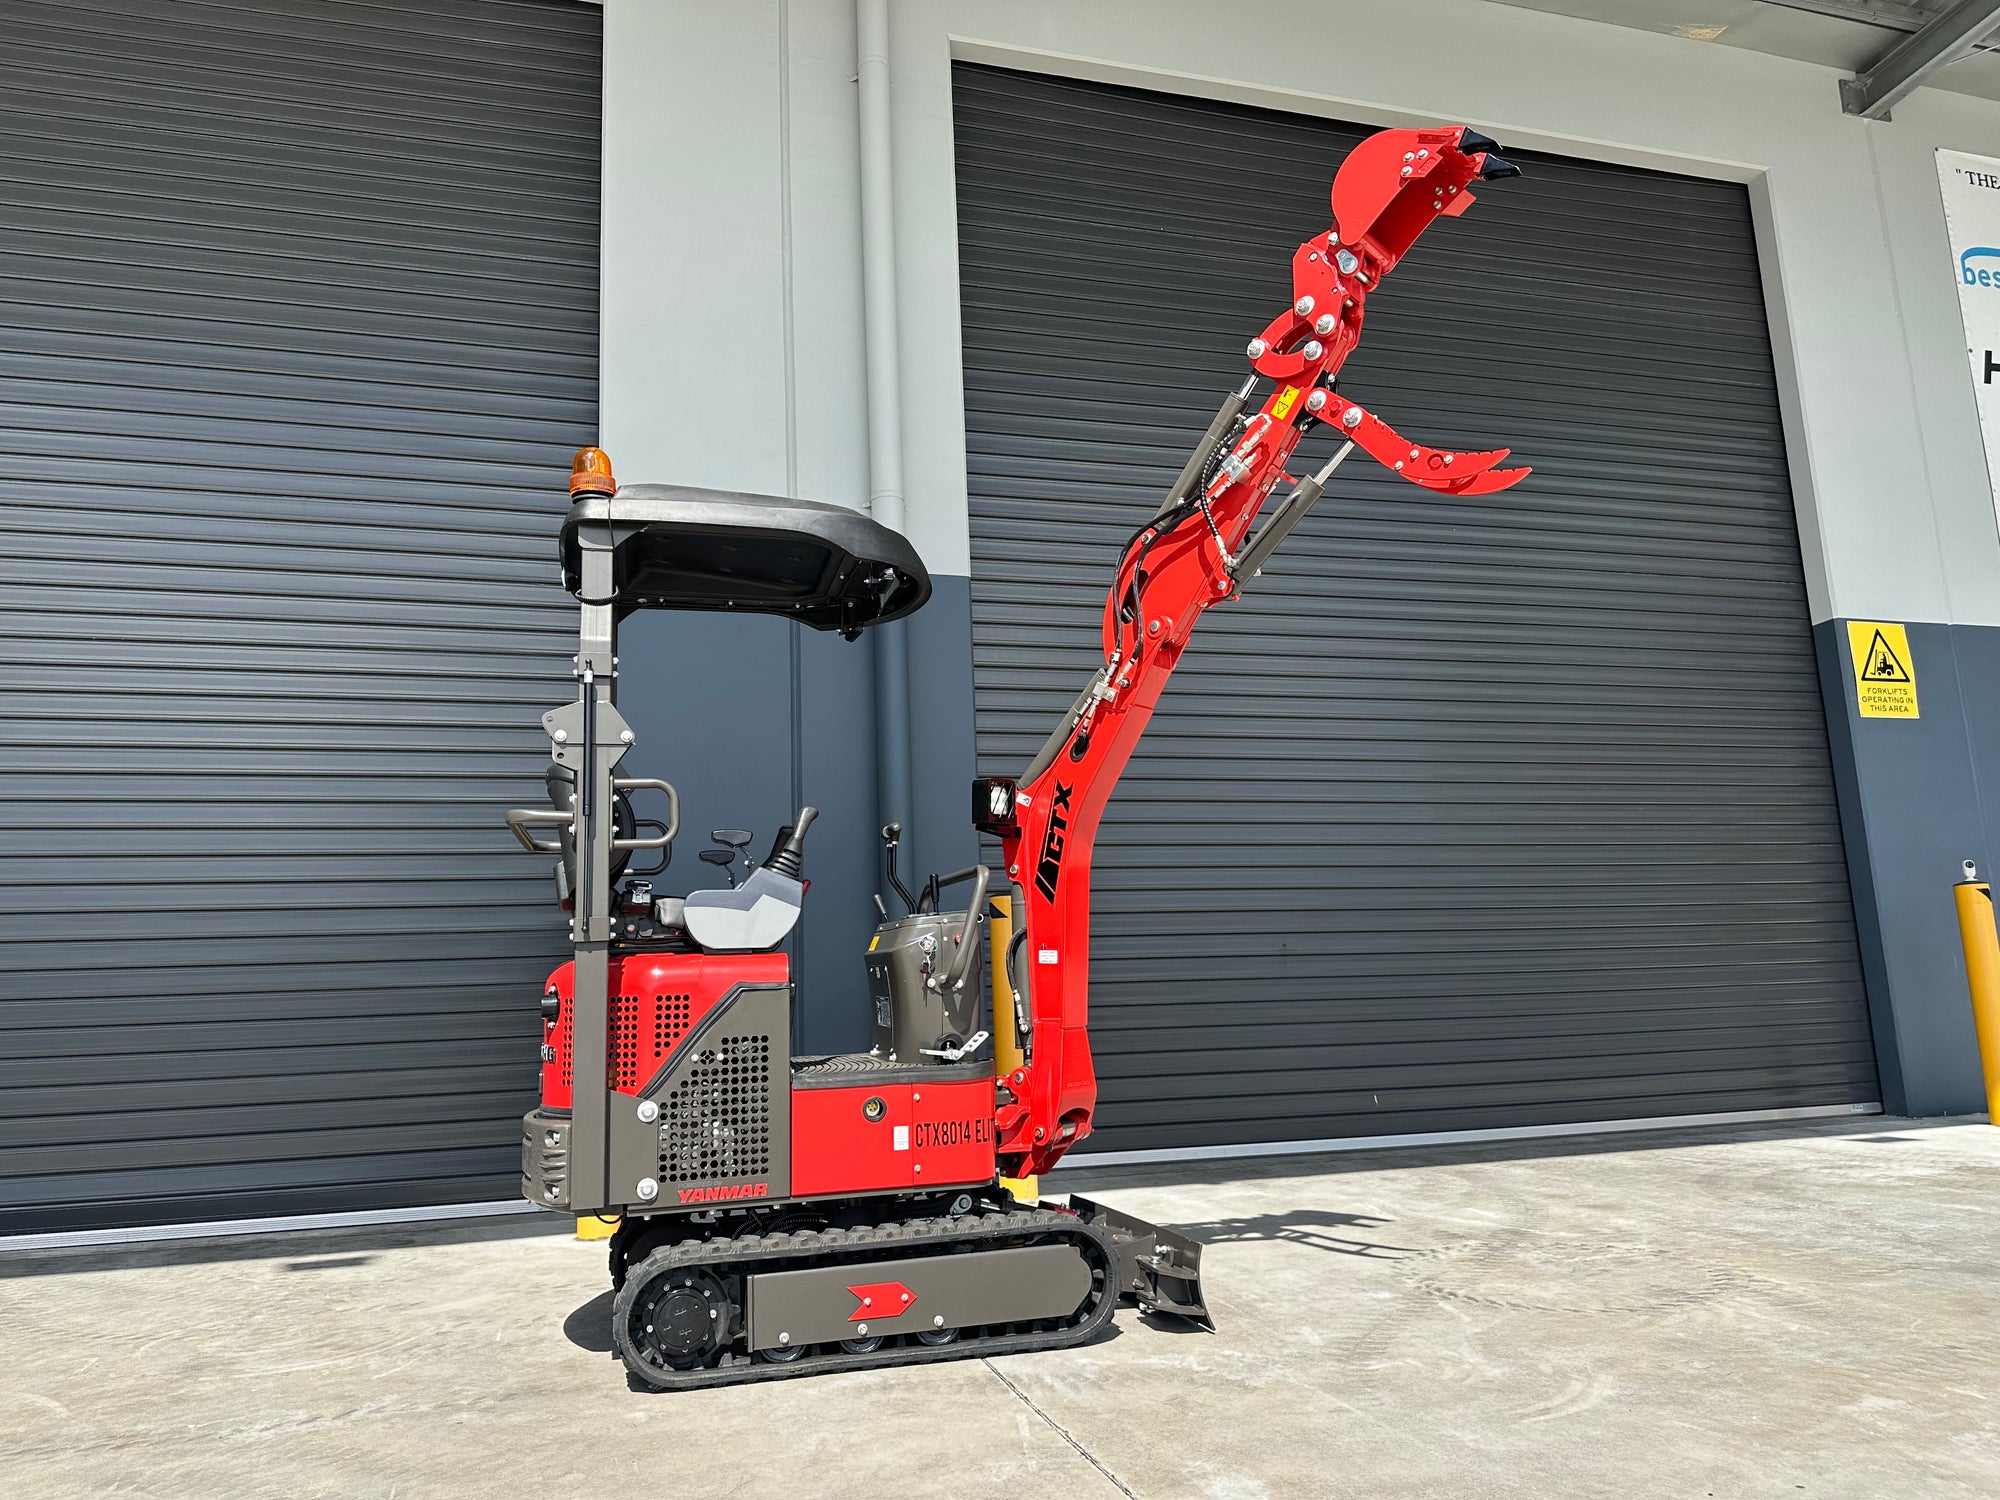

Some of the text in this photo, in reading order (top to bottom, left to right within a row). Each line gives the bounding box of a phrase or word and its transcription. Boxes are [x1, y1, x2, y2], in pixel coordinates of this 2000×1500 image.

[1965, 171, 2000, 189] THE
[915, 1119, 971, 1148] CTX8014
[677, 1183, 768, 1204] YANMAR
